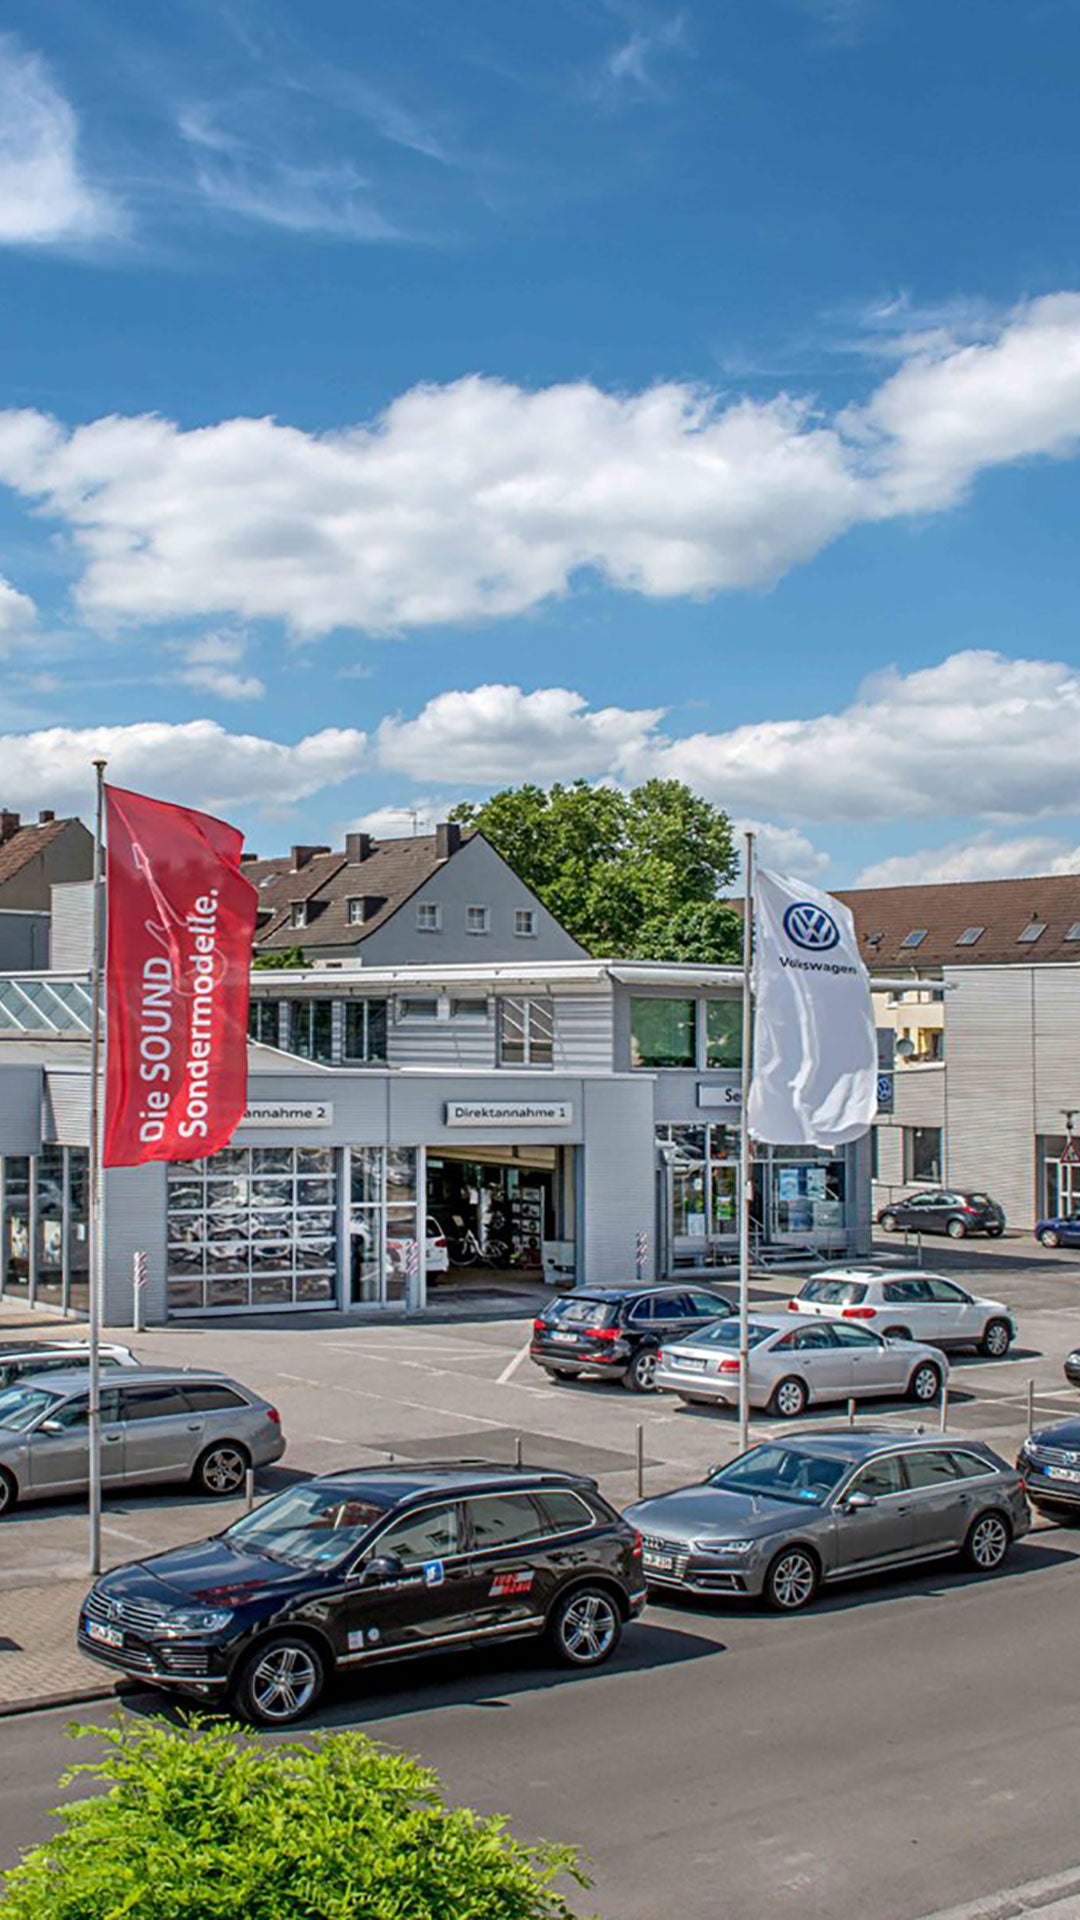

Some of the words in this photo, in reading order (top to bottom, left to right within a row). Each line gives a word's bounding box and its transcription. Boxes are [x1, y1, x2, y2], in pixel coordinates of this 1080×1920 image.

[140, 957, 173, 1082] SOUND
[178, 888, 218, 1138] Sondermodelle.
[243, 1106, 313, 1118] annahme
[317, 1106, 325, 1118] 2
[455, 1106, 555, 1118] Direktannahme
[559, 1107, 566, 1118] 1
[725, 1087, 742, 1103] Se
[140, 1090, 169, 1142] Die
